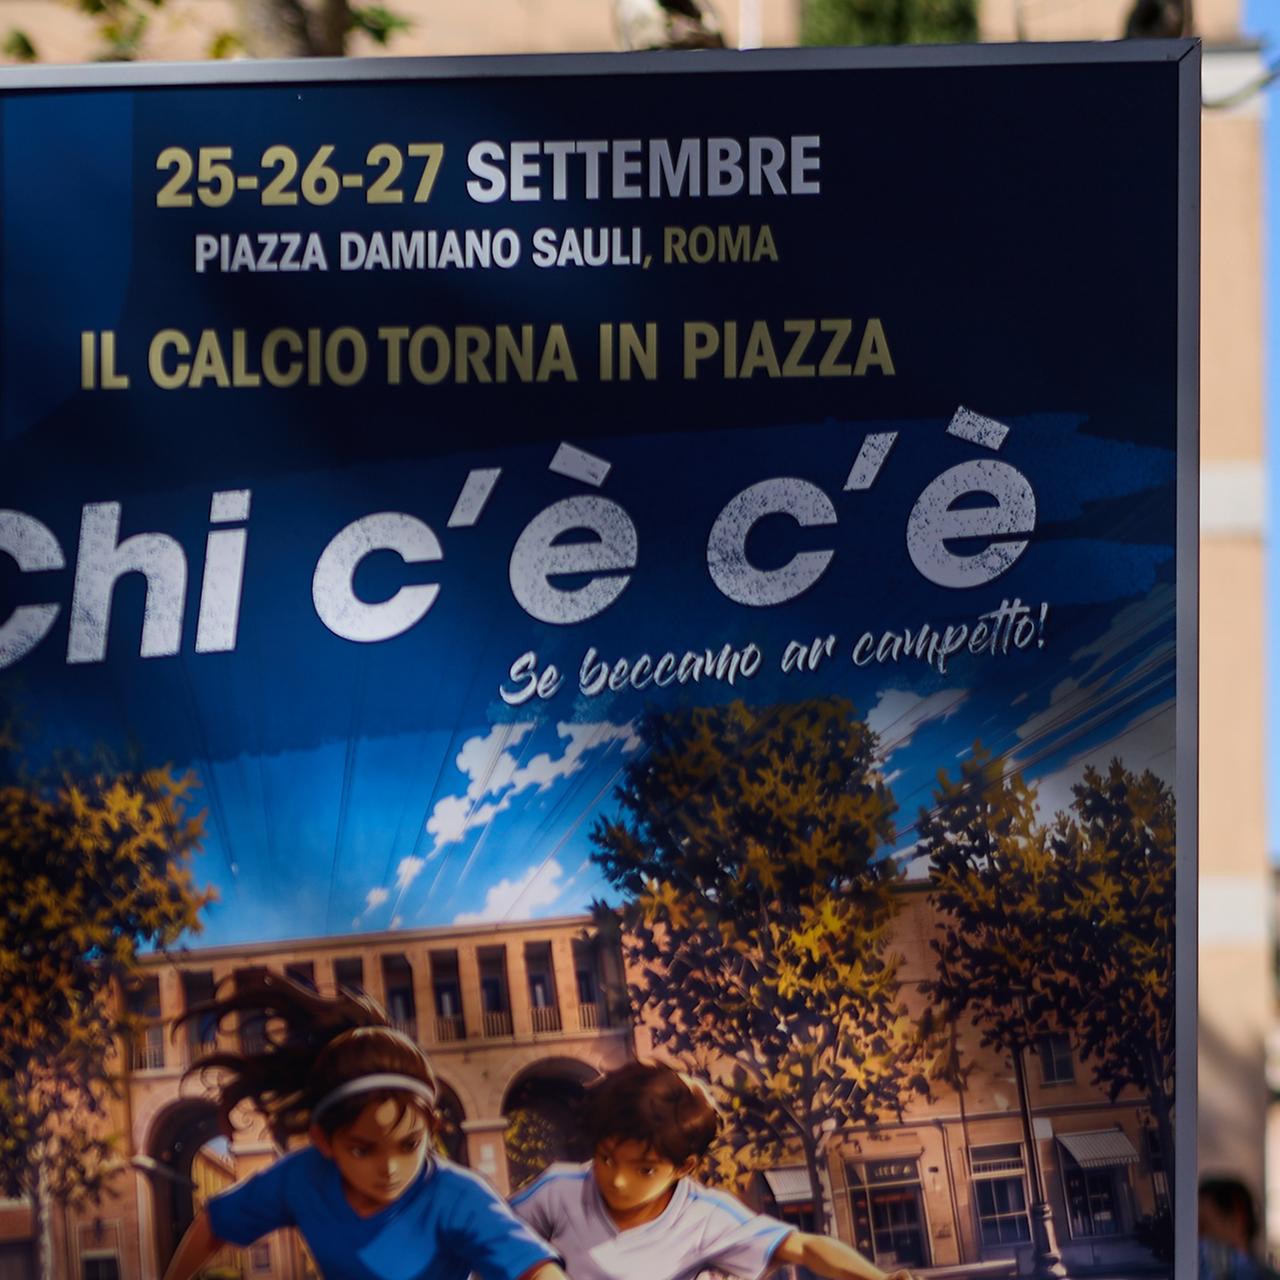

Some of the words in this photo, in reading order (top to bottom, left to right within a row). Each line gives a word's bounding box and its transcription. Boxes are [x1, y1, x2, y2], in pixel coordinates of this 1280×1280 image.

[155, 143, 444, 208] 25-26-27
[466, 135, 821, 203] SETTEMBRE
[195, 232, 328, 273] PIAZZA
[340, 228, 521, 270] DAMIANO
[532, 226, 653, 269] SAULI,
[663, 224, 779, 264] ROMA
[81, 330, 130, 390] IL
[147, 328, 369, 390] CALCIO
[377, 325, 579, 385] TORNA
[598, 322, 658, 381] IN
[683, 317, 897, 379] PIAZZA
[499, 650, 563, 705] Se
[578, 643, 763, 697] beccamo
[780, 633, 836, 673] ar
[851, 598, 1050, 674] campetto!
